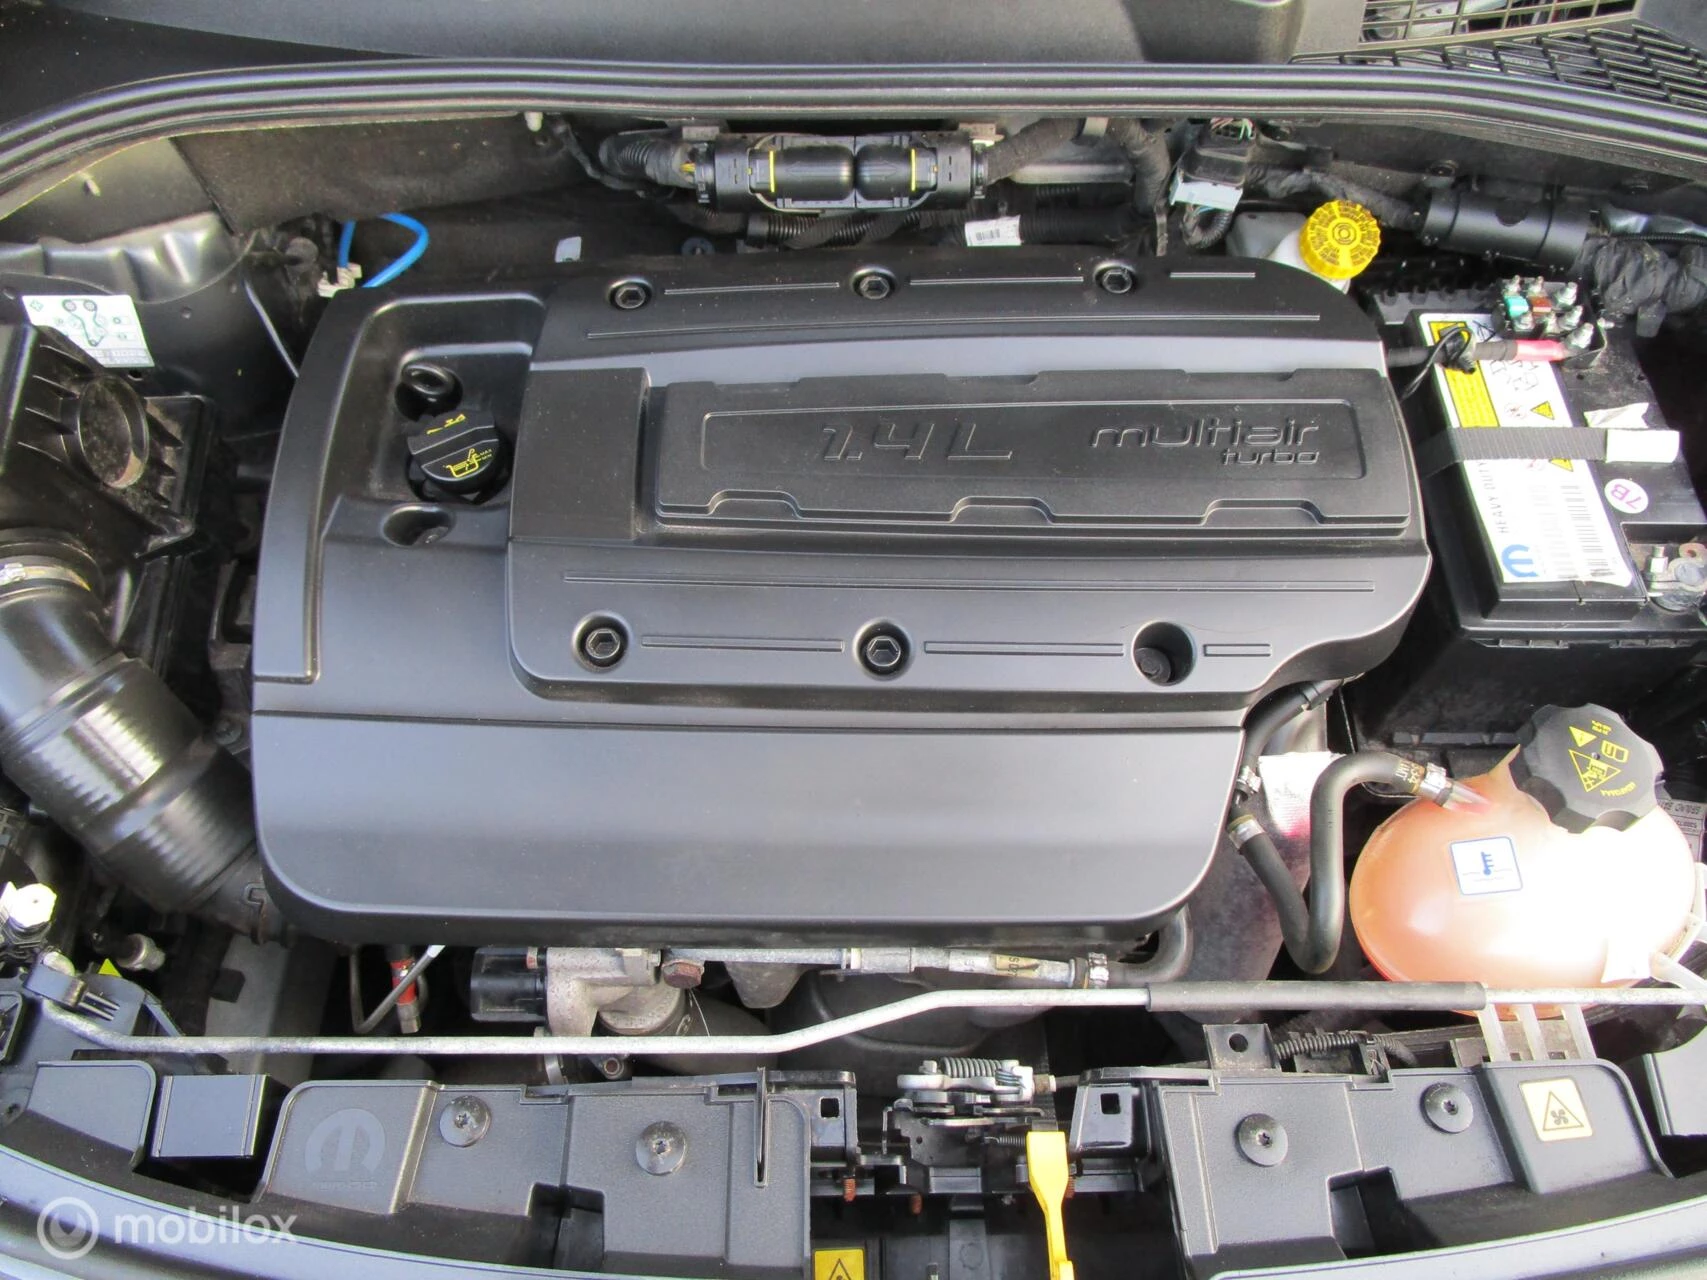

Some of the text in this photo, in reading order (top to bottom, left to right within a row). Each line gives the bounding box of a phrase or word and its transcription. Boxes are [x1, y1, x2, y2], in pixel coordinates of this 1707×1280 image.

[1090, 416, 1320, 449] multiair
[1221, 447, 1321, 466] turbo
[1488, 495, 1510, 534] HEAVY
